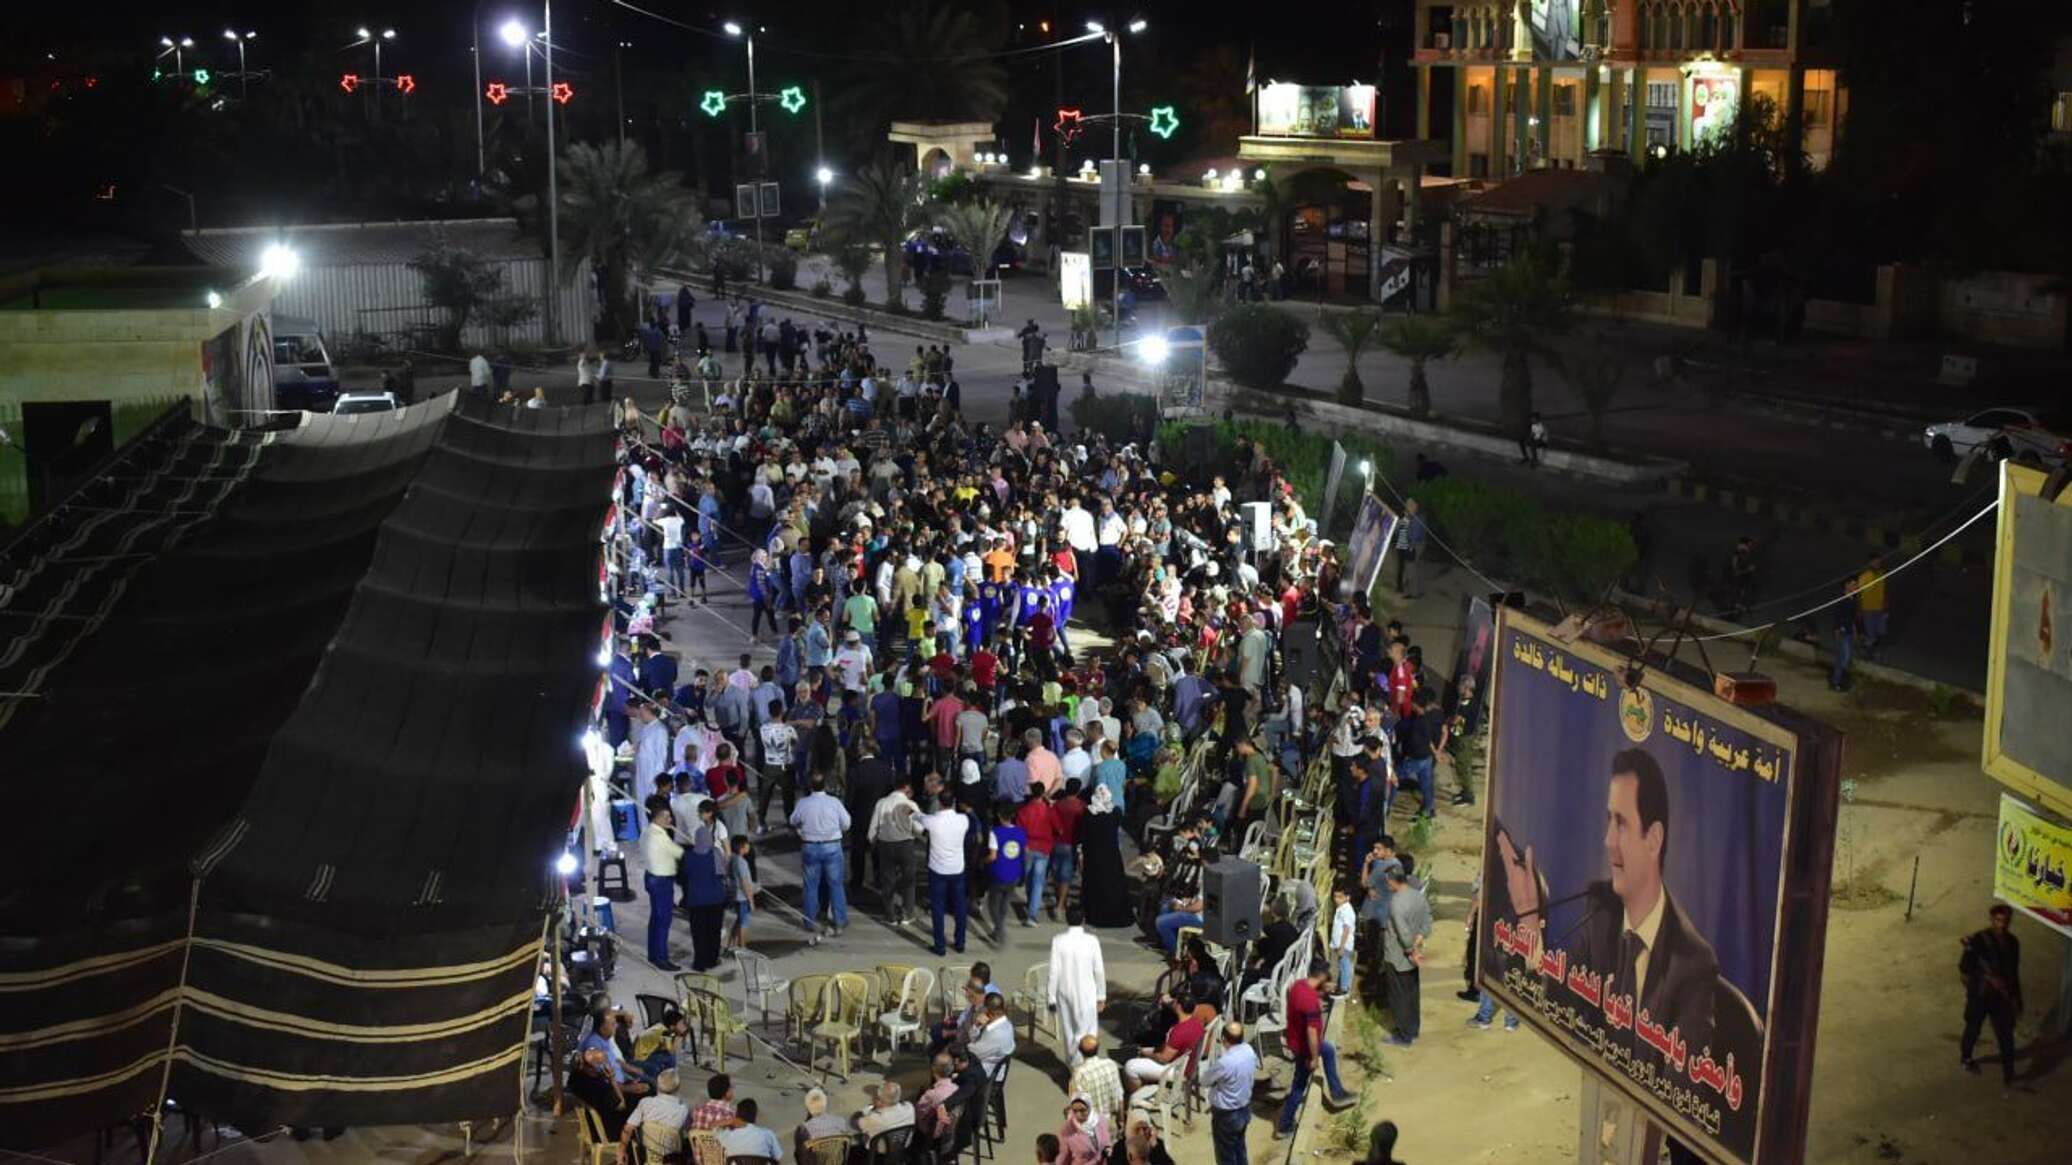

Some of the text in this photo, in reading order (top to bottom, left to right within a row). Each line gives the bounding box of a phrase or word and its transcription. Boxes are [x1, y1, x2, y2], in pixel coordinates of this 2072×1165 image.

[1513, 635, 1607, 700] ذات رسالة خالدة
[1663, 707, 1705, 755] واحدة
[1708, 727, 1750, 771] عربية
